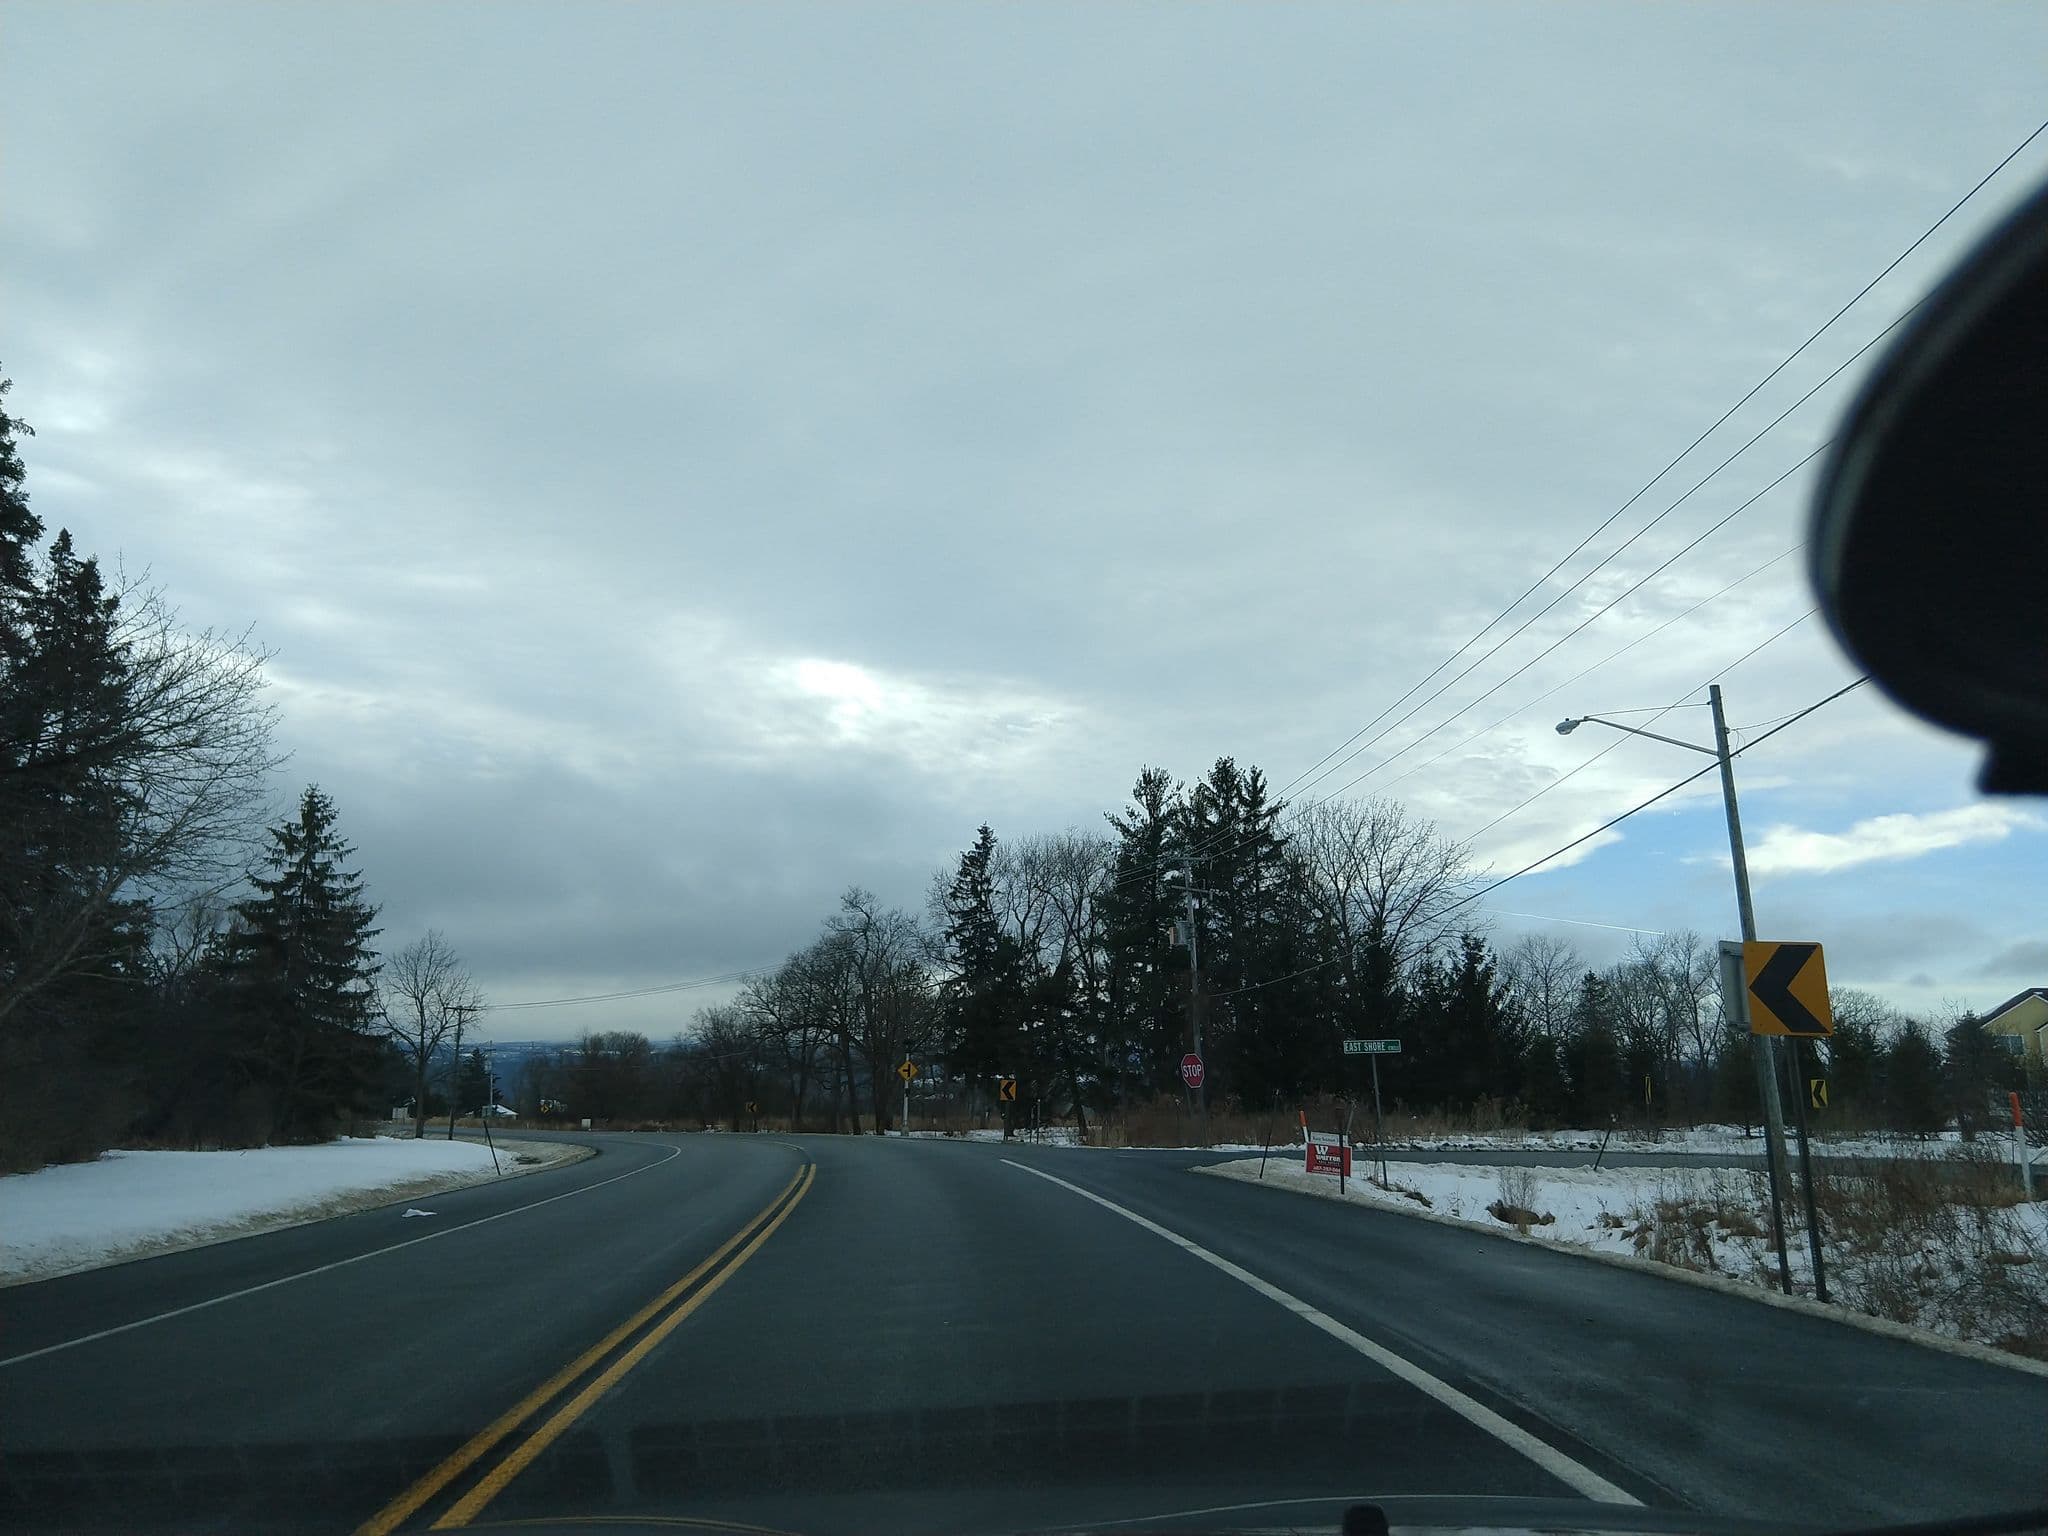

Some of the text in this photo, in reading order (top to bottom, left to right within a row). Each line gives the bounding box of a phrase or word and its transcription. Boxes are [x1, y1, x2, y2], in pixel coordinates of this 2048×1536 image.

[1345, 1042, 1361, 1052] EAST
[1364, 1042, 1385, 1051] SHORE
[1183, 1064, 1202, 1078] STOP
[1315, 1145, 1328, 1155] W
